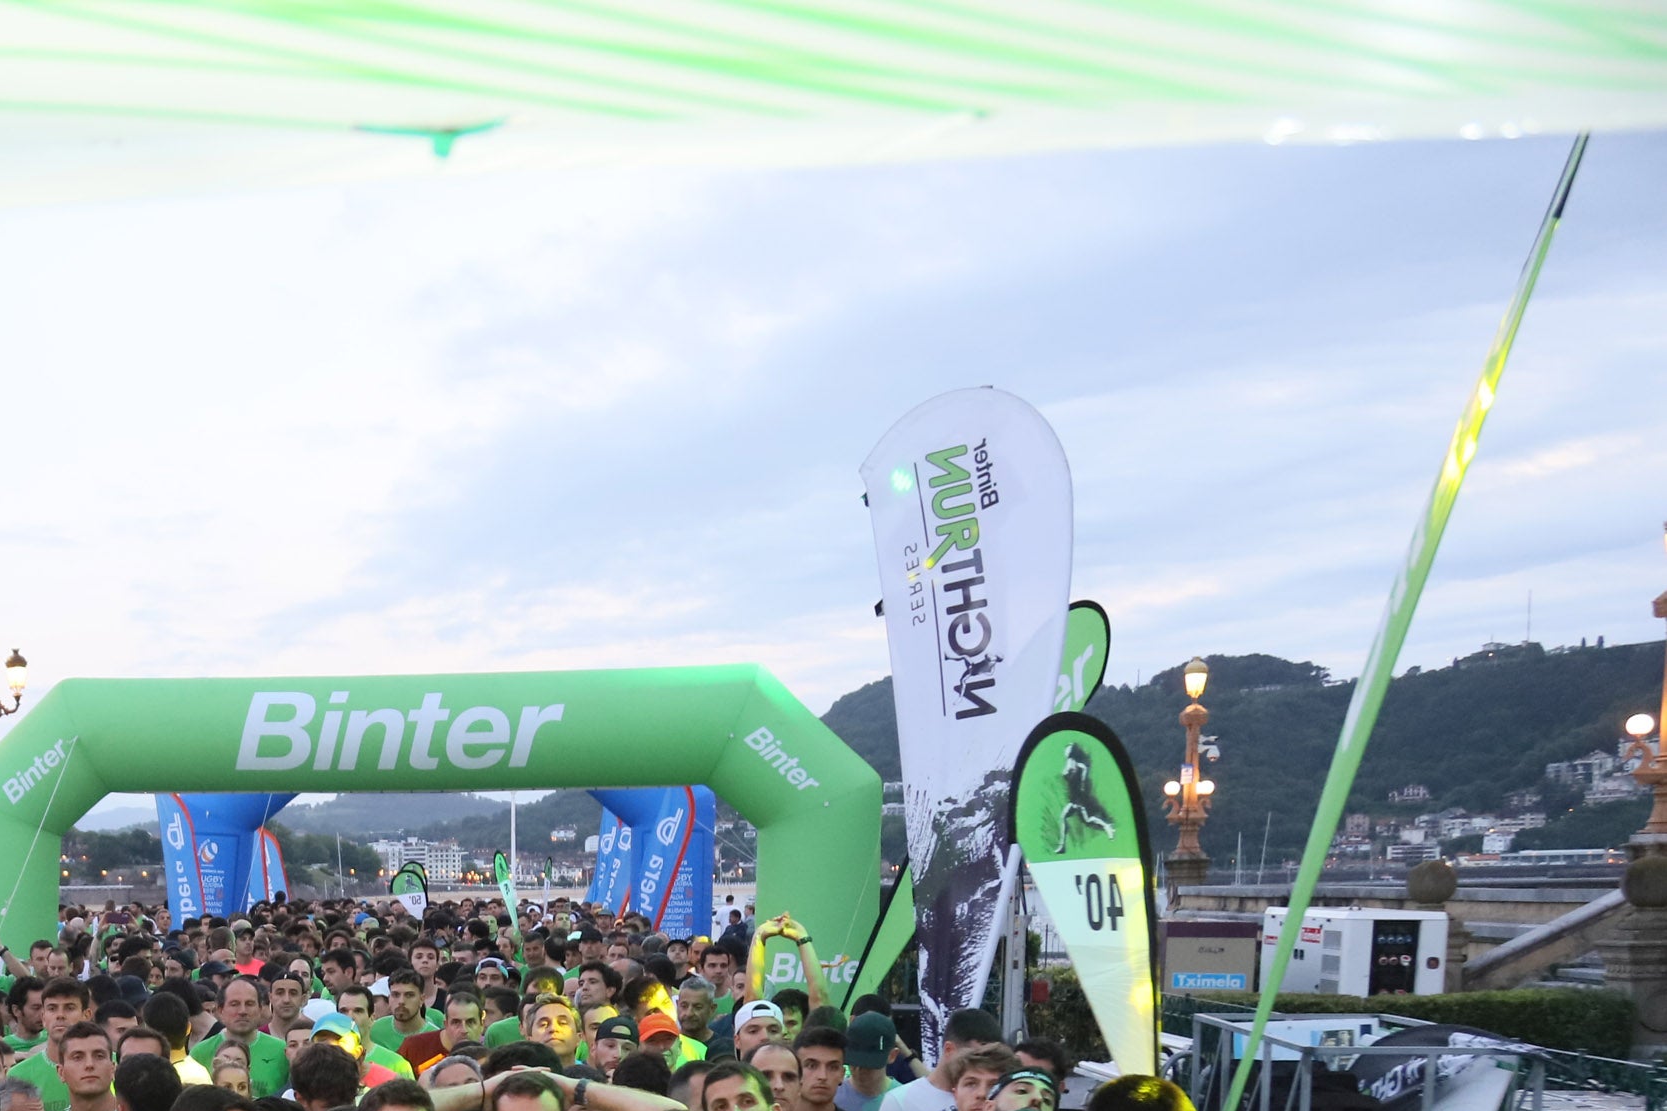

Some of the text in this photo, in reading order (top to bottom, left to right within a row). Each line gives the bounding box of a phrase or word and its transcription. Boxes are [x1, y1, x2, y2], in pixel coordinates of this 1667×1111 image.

[235, 690, 564, 772] Binter
[743, 726, 820, 792] Binter
[2, 737, 69, 805] Binter
[1176, 974, 1242, 988] Tximela
